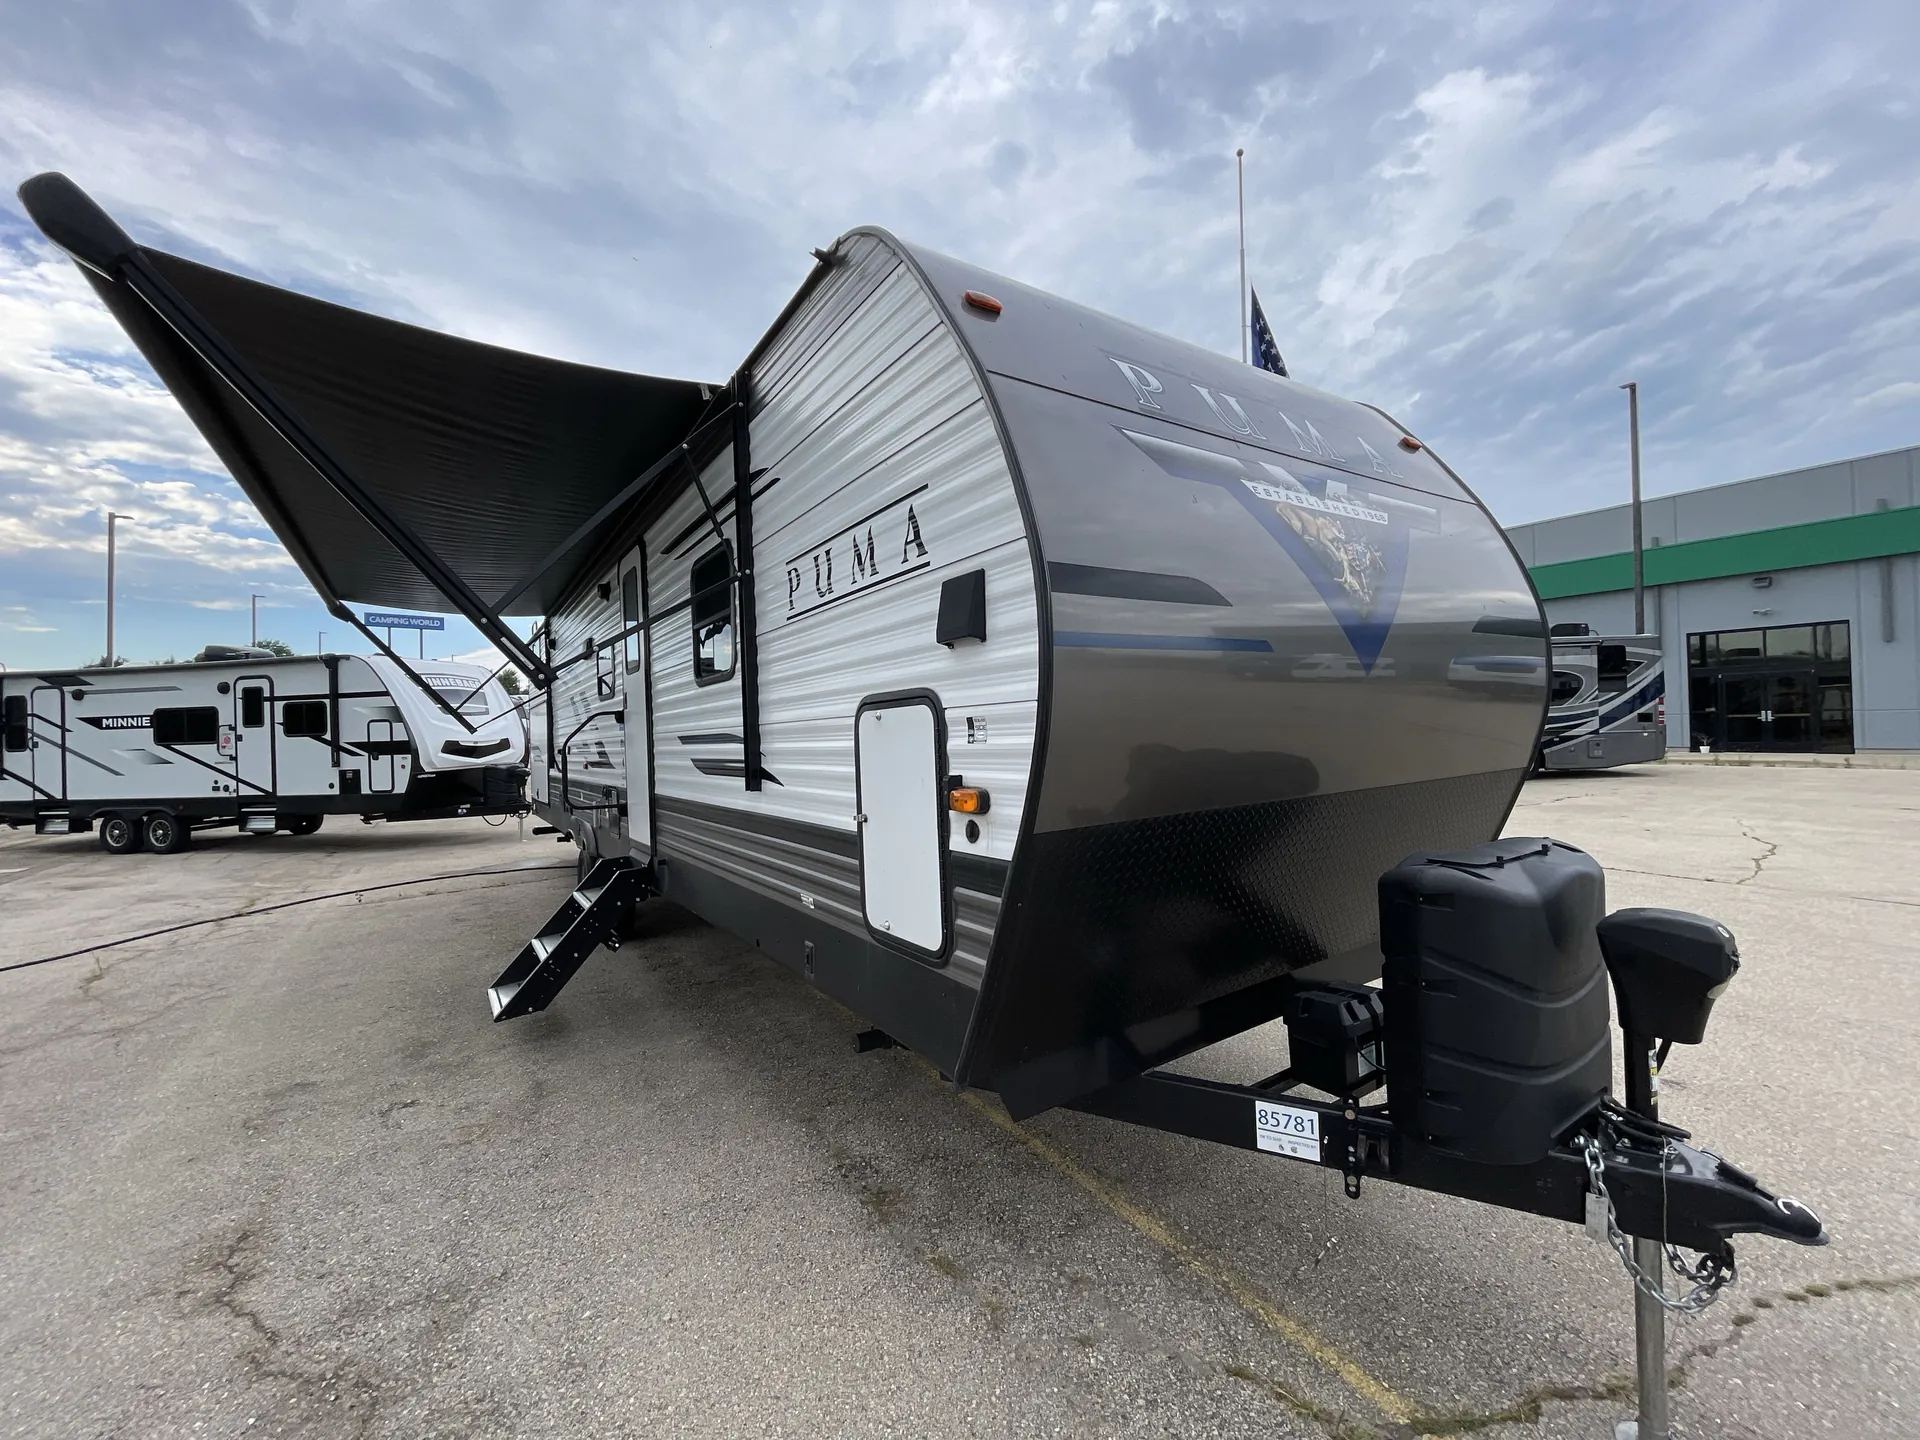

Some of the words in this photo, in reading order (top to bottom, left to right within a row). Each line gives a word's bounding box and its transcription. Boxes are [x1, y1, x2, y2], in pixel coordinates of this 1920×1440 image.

[1109, 357, 1403, 478] PUMA
[1251, 485, 1361, 516] ESTABLISHED
[787, 504, 928, 612] PUMA
[369, 616, 409, 625] CAMPING
[410, 619, 440, 627] WORLD
[424, 676, 482, 690] INNEBAGO
[102, 716, 151, 728] MINNIE
[1258, 1108, 1315, 1135] 85781
